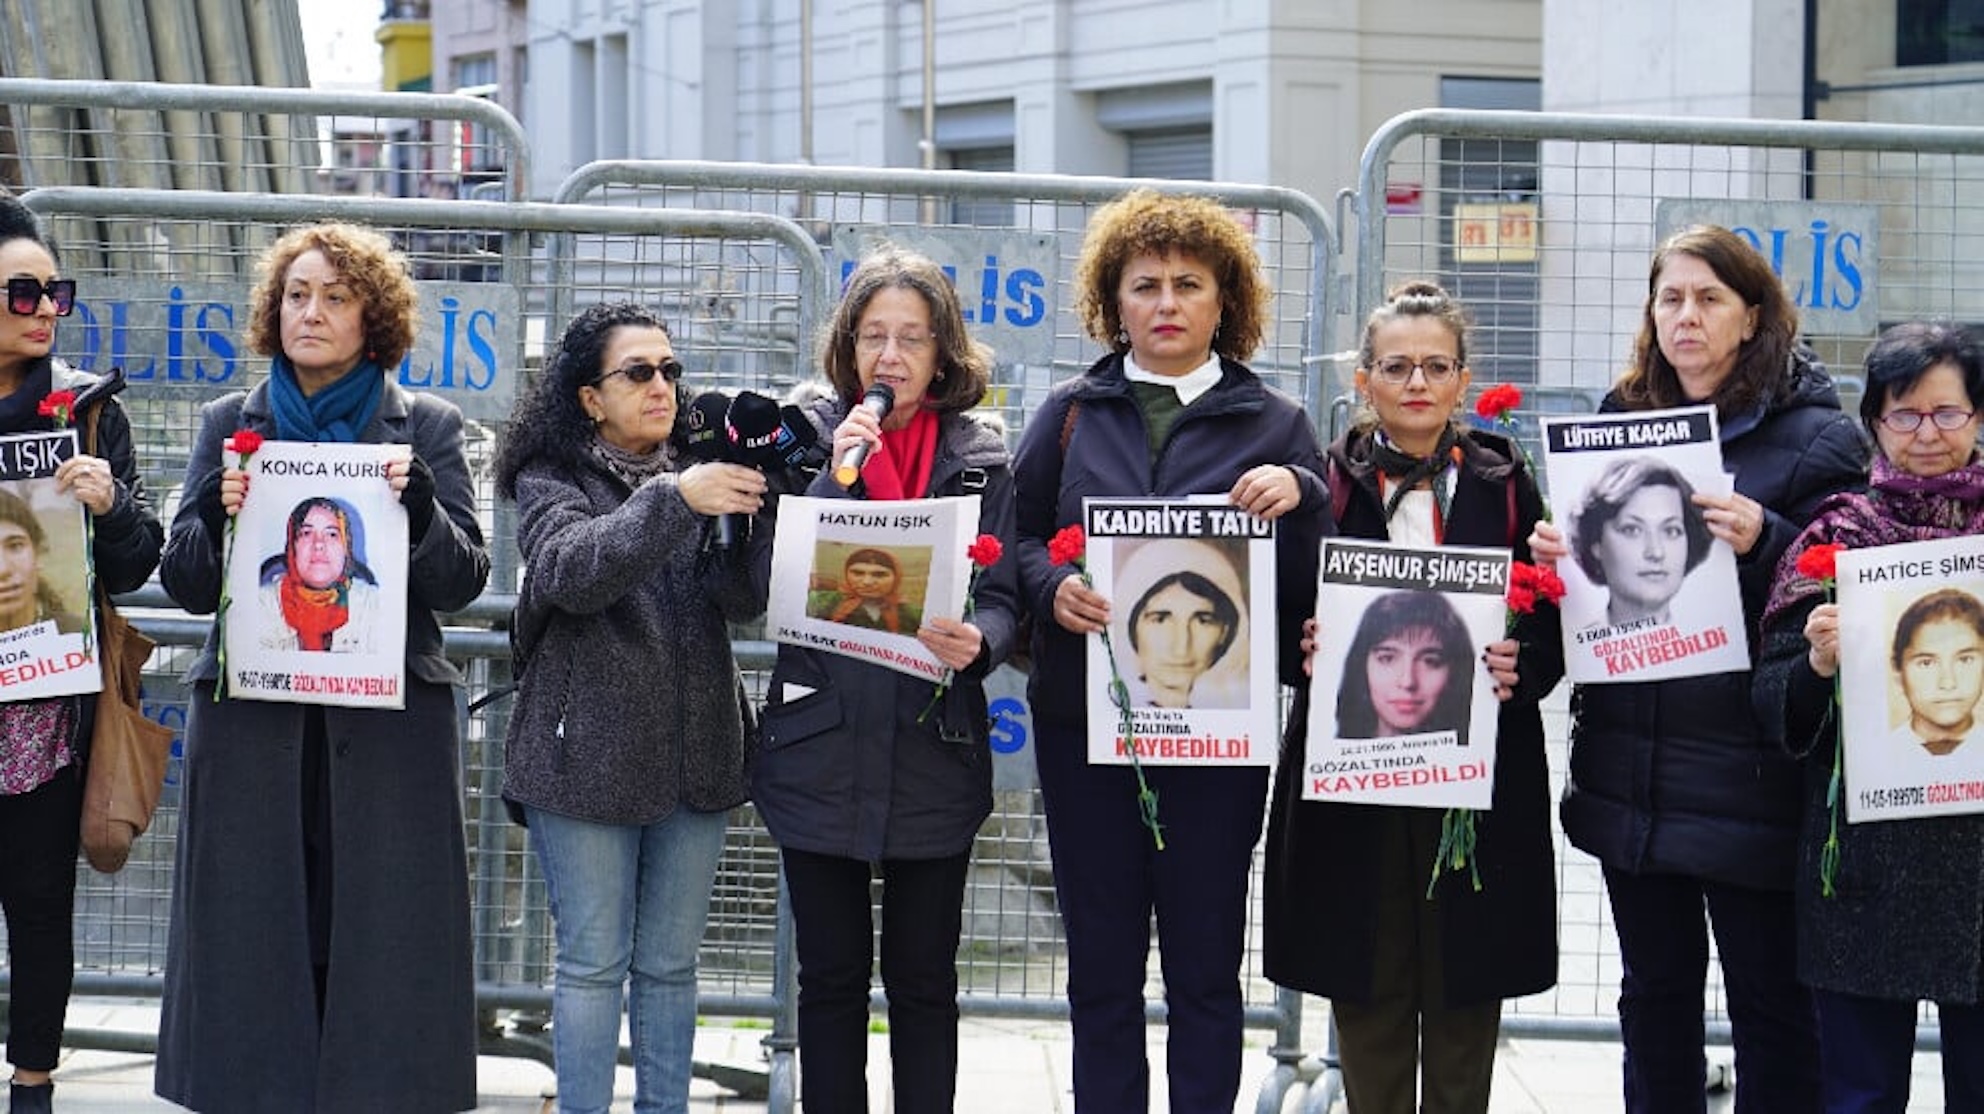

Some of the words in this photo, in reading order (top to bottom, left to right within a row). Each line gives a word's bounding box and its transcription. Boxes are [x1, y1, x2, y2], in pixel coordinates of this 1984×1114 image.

[1730, 220, 1863, 311] LİS
[53, 286, 237, 384] OLİS
[398, 298, 496, 391] LİS
[1627, 420, 1690, 445] KAÇAR
[15, 439, 63, 478] IŞIK
[261, 459, 327, 476] KONCA
[818, 512, 887, 528] HATUN
[1093, 504, 1201, 535] KADRİYE
[1327, 551, 1422, 582] AYŞENUR
[1427, 553, 1505, 591] ŞİMŞEK
[1859, 560, 1933, 583] HATİCE
[1576, 633, 1584, 643] 5
[1593, 626, 1681, 658] GÖZALTINDA
[1605, 626, 1729, 676] KAYBEDİLDİ
[1116, 733, 1249, 759] KAYBEDİLDİ
[1310, 754, 1426, 774] GÖZALTINDA
[1313, 761, 1486, 795] KAYBEDİLDİ
